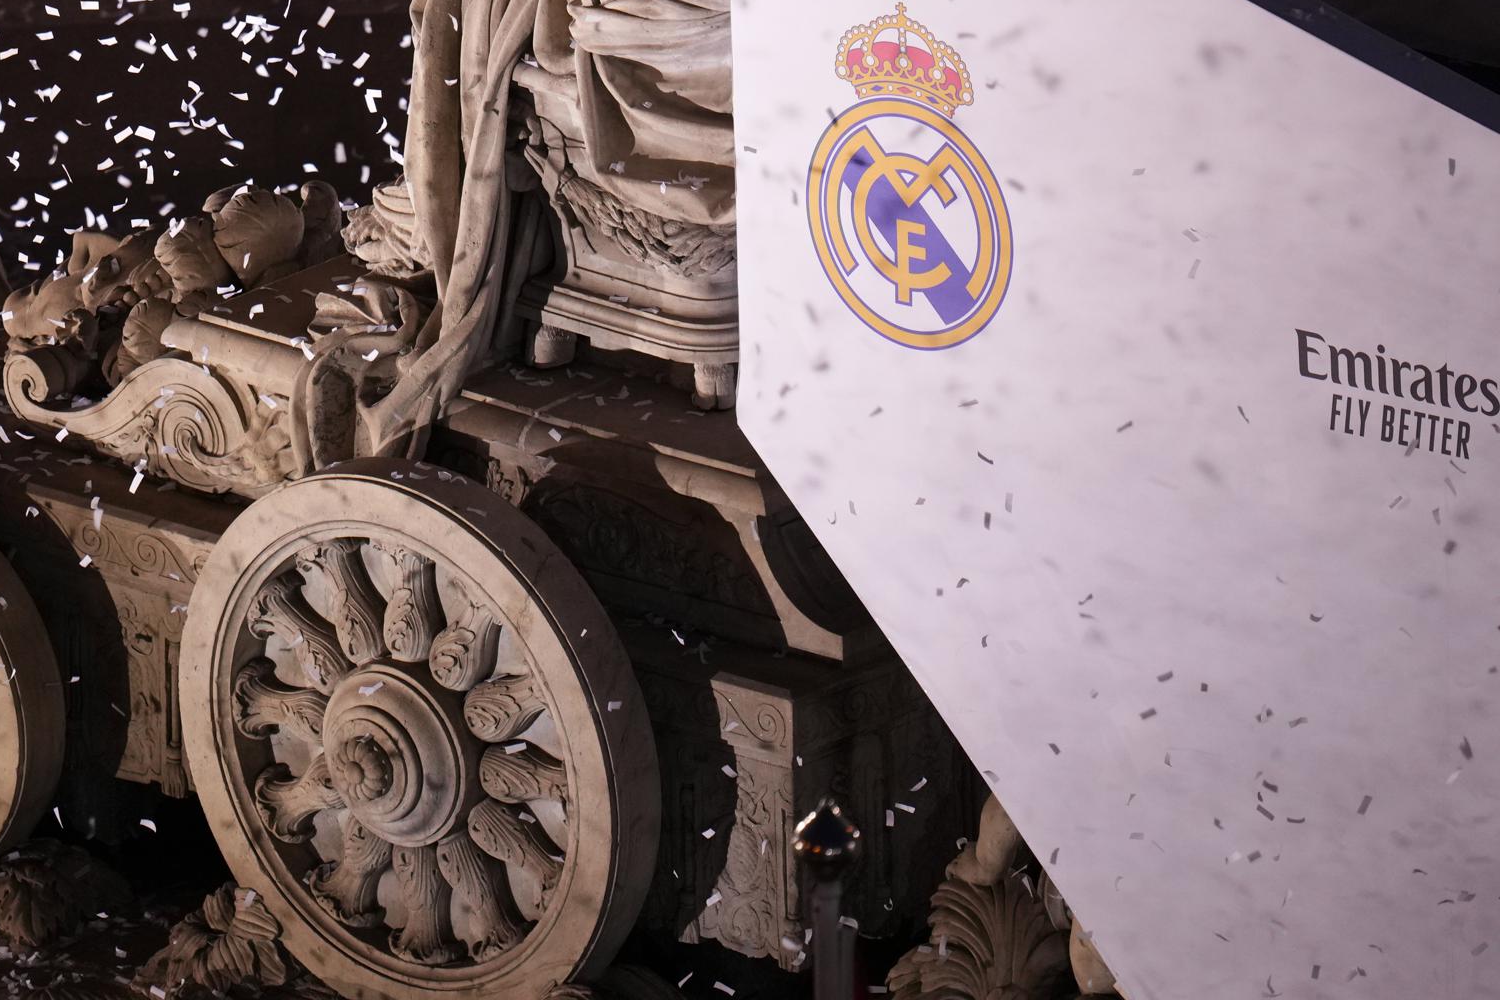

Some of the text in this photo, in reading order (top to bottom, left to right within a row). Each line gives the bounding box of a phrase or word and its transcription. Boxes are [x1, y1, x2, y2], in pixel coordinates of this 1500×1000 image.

[1295, 328, 1500, 417] Emirates
[1329, 393, 1471, 460] FLY BETTER
